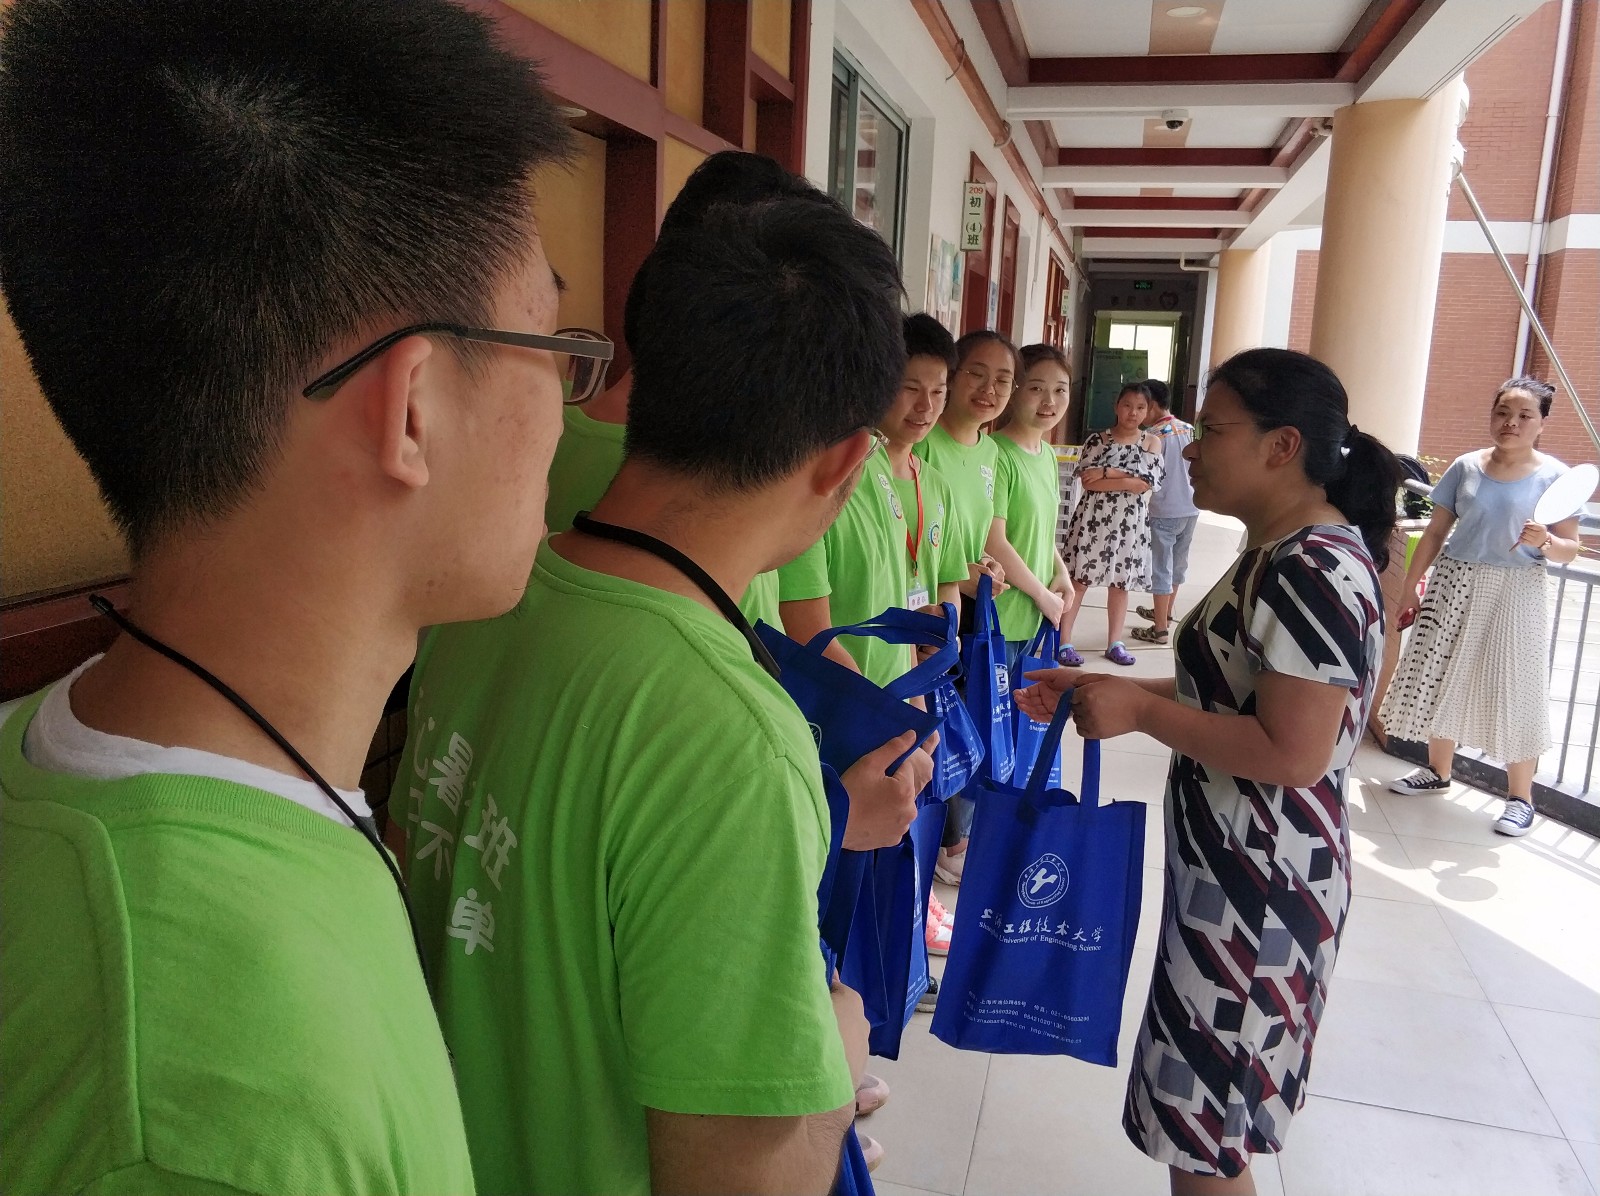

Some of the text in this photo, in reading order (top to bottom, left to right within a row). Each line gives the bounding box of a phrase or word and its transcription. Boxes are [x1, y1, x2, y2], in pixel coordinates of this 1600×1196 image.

[968, 186, 983, 195] 209
[966, 196, 982, 246] 初一(4)班
[999, 934, 1029, 944] University
[1030, 934, 1039, 942] of
[1040, 935, 1077, 951] Engineering
